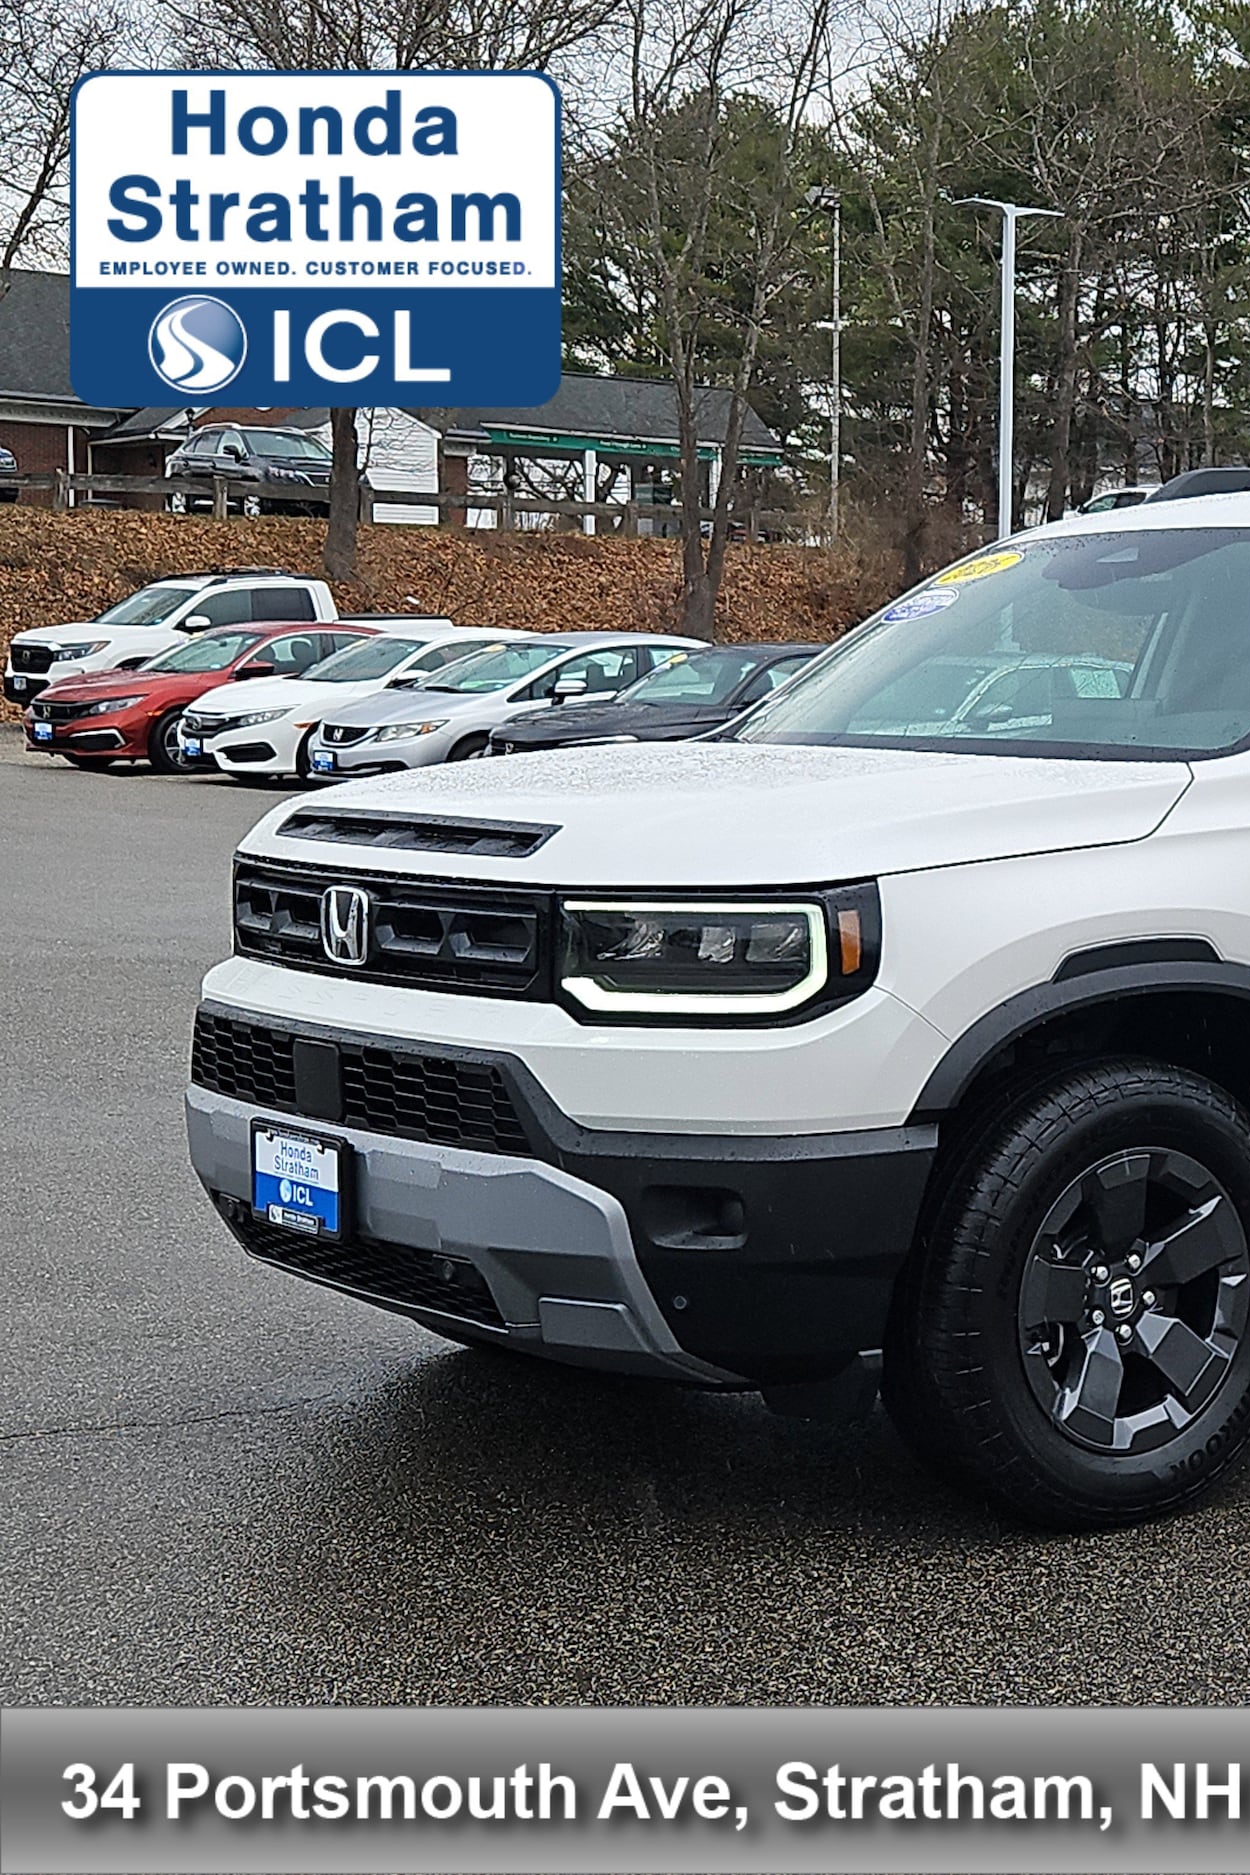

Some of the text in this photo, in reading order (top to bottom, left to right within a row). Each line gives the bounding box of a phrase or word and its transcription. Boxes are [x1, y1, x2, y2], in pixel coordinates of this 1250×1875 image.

[280, 1141, 312, 1163] Honda
[274, 1155, 319, 1180] Stratham
[292, 1184, 314, 1207] ICL
